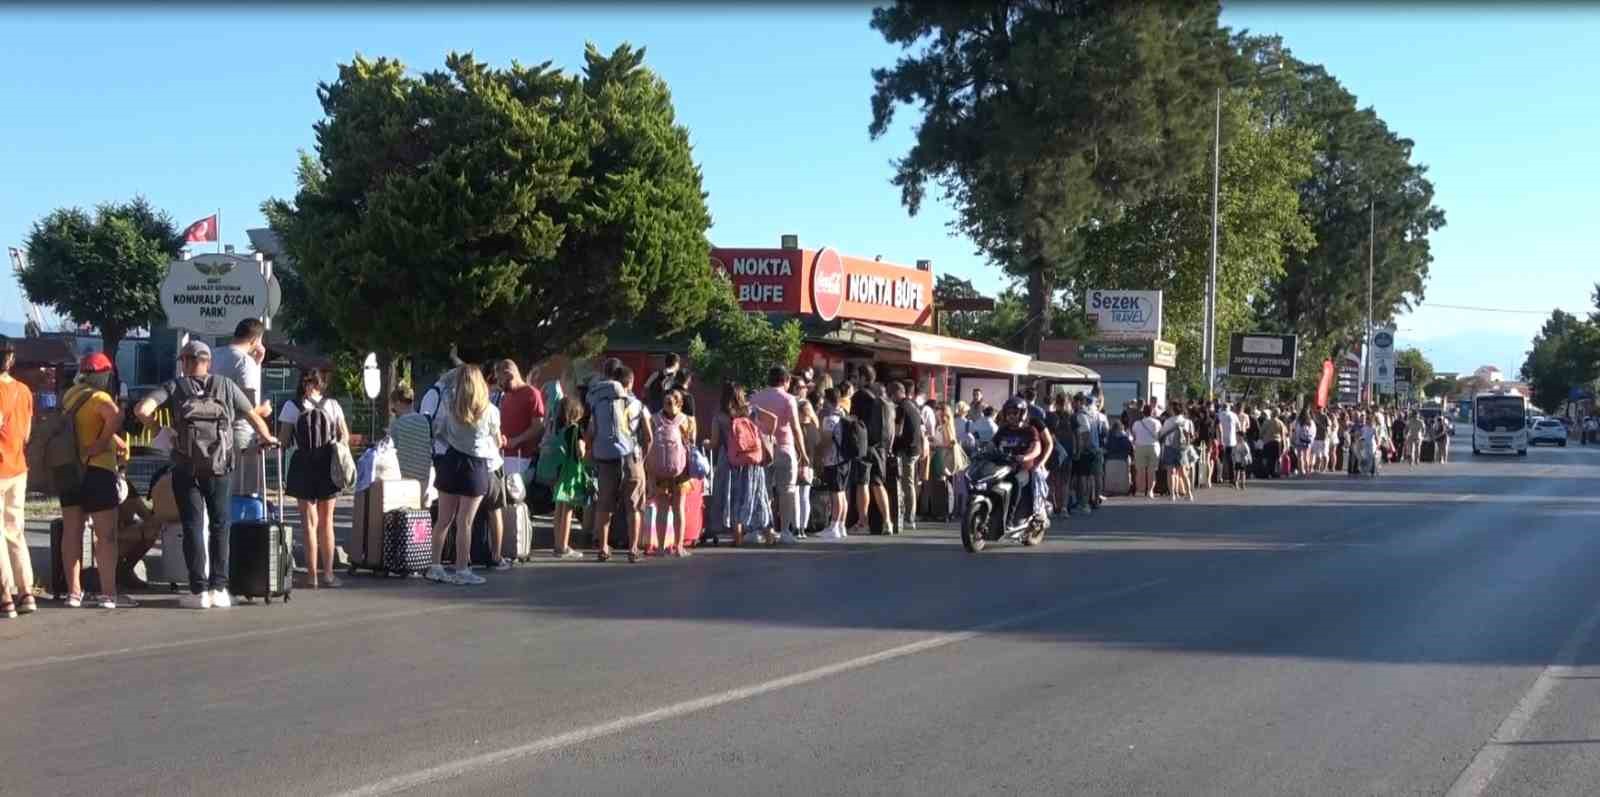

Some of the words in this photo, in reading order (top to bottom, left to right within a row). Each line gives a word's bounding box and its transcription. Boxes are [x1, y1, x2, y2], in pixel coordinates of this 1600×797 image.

[733, 258, 792, 276] NOKTA
[173, 294, 221, 305] KONURALP
[223, 293, 255, 305] ÖZCAN
[739, 282, 784, 302] BÜFE
[848, 273, 892, 305] NOKTA
[894, 277, 923, 312] BÜFE
